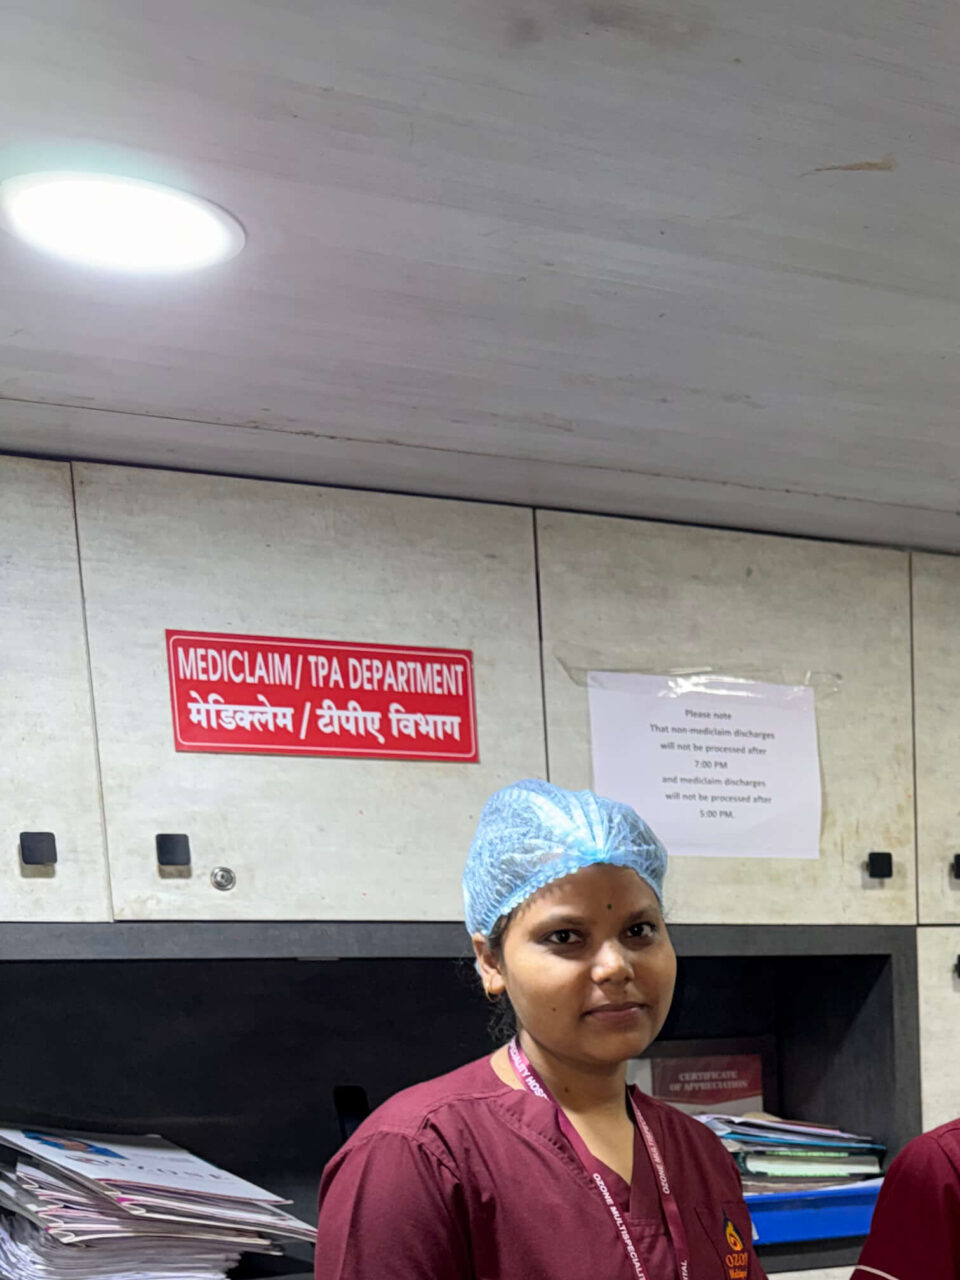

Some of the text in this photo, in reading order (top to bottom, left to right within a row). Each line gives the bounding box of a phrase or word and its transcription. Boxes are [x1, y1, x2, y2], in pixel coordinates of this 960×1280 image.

[307, 655, 344, 689] TPA
[348, 657, 464, 696] DEPARTMENT
[187, 691, 294, 733] मेडिक्लेम
[316, 699, 385, 744] टीपीए
[389, 703, 462, 741] विभाग
[684, 709, 732, 720] Please note
[650, 724, 775, 740] That non-mediclaim discharges
[660, 742, 767, 755] will not be processed after
[694, 759, 712, 769] 7:00
[662, 775, 766, 788] and mediclaim discharges
[665, 791, 772, 805] will not be processed after
[593, 1173, 614, 1206] OZONE
